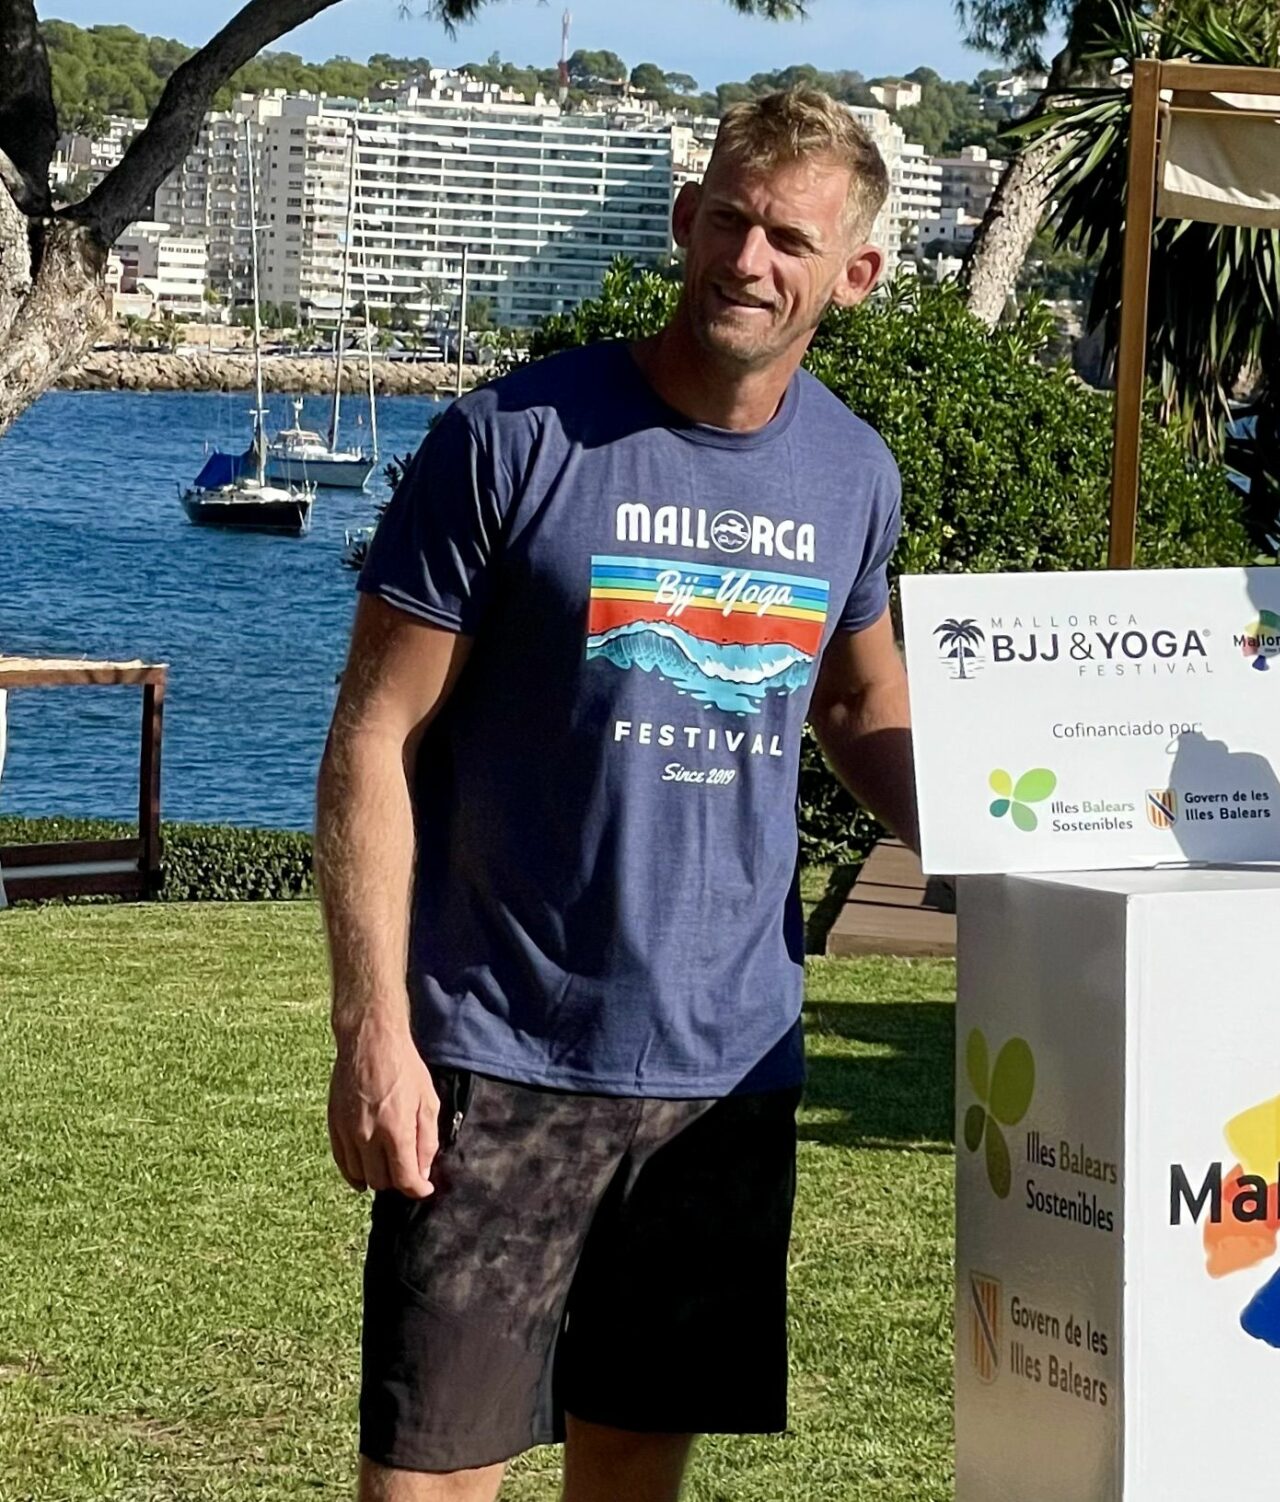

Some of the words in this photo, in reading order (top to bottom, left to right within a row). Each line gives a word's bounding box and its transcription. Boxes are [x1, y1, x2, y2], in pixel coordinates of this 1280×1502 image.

[991, 613, 1138, 629] MALLORCA
[992, 634, 1059, 662] BJJ
[1079, 662, 1214, 677] FESTIVAL
[614, 721, 783, 757] FESTIVAL
[1052, 721, 1165, 740] Cofinanciado
[662, 763, 705, 783] Since
[706, 767, 736, 785] 2019
[1051, 801, 1079, 815] Illes
[1082, 799, 1136, 814] Balears
[1184, 791, 1229, 804] Govern
[1232, 790, 1247, 803] de
[1250, 790, 1270, 802] les
[1184, 807, 1214, 821] Illes
[1219, 805, 1271, 820] Balears
[1052, 816, 1134, 832] Sostenibles
[1026, 1132, 1056, 1169] Illes
[1058, 1140, 1118, 1186] Balears
[1025, 1180, 1114, 1233] Sostenibles
[1010, 1295, 1060, 1340] Govern
[1064, 1314, 1083, 1347] de
[1086, 1319, 1108, 1356] les
[1010, 1342, 1042, 1382] Illes
[1048, 1354, 1108, 1407] Balears
